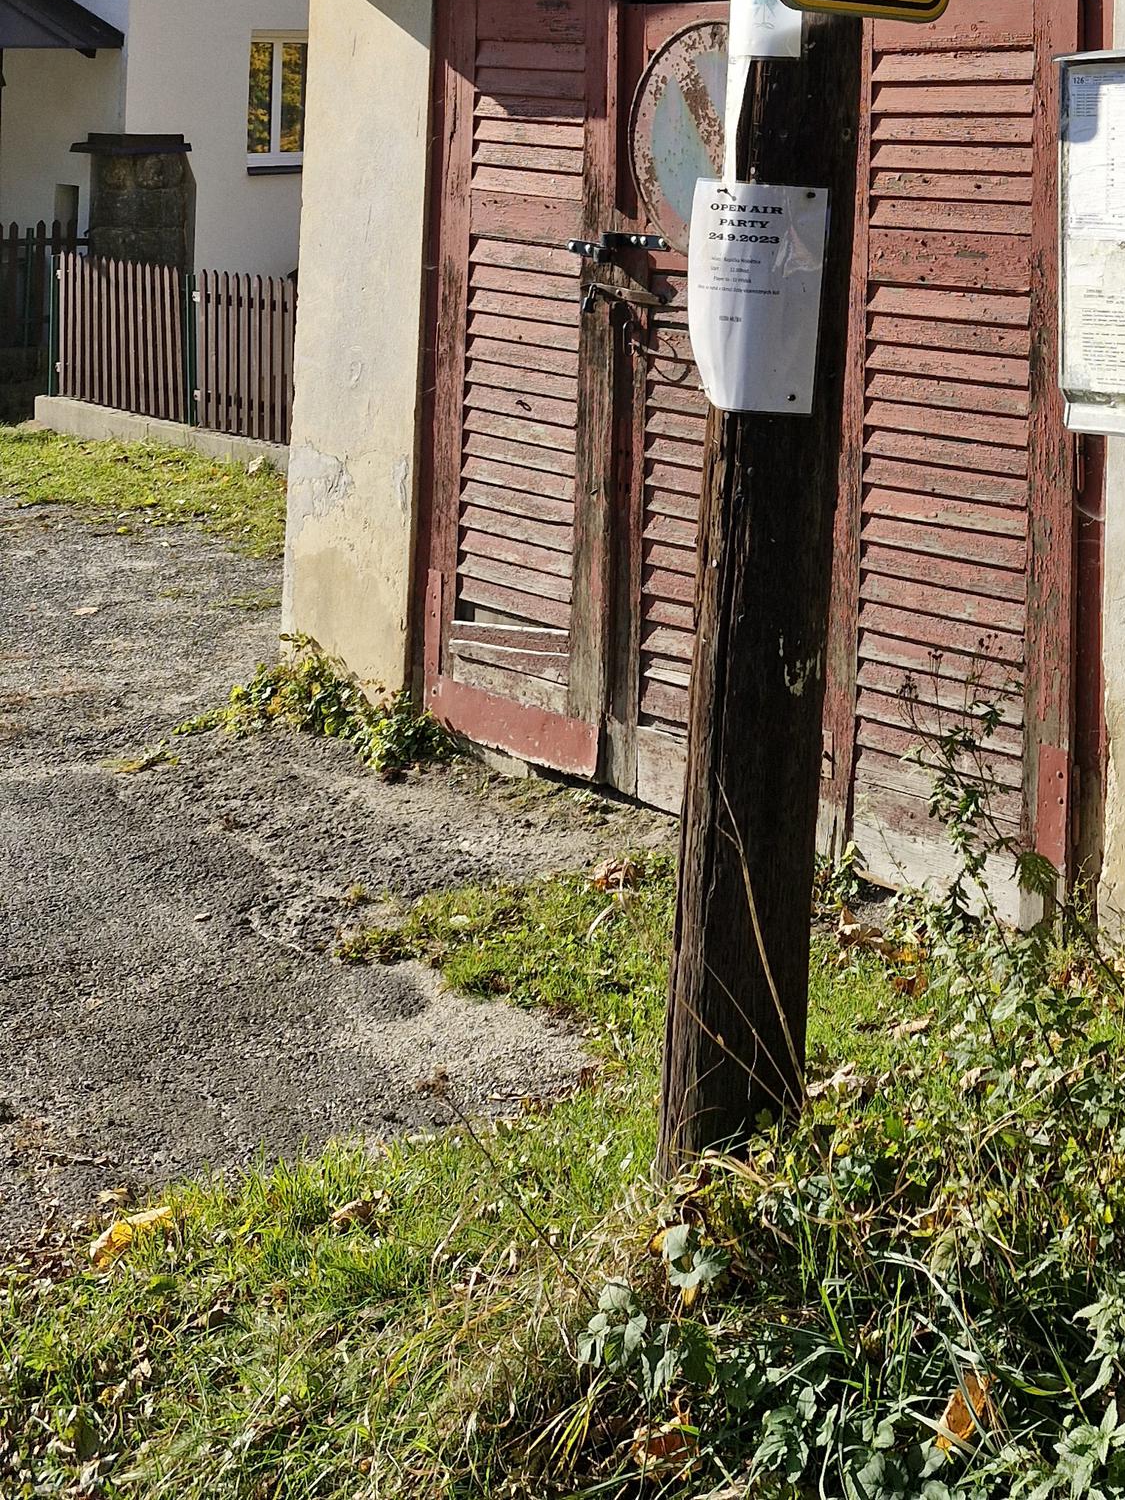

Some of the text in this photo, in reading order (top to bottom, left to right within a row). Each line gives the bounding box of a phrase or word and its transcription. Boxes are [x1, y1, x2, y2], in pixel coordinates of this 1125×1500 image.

[1072, 76, 1085, 85] 126
[710, 203, 784, 215] OPEN AIR
[719, 218, 770, 229] PARTY
[708, 232, 780, 244] 24.9.2023
